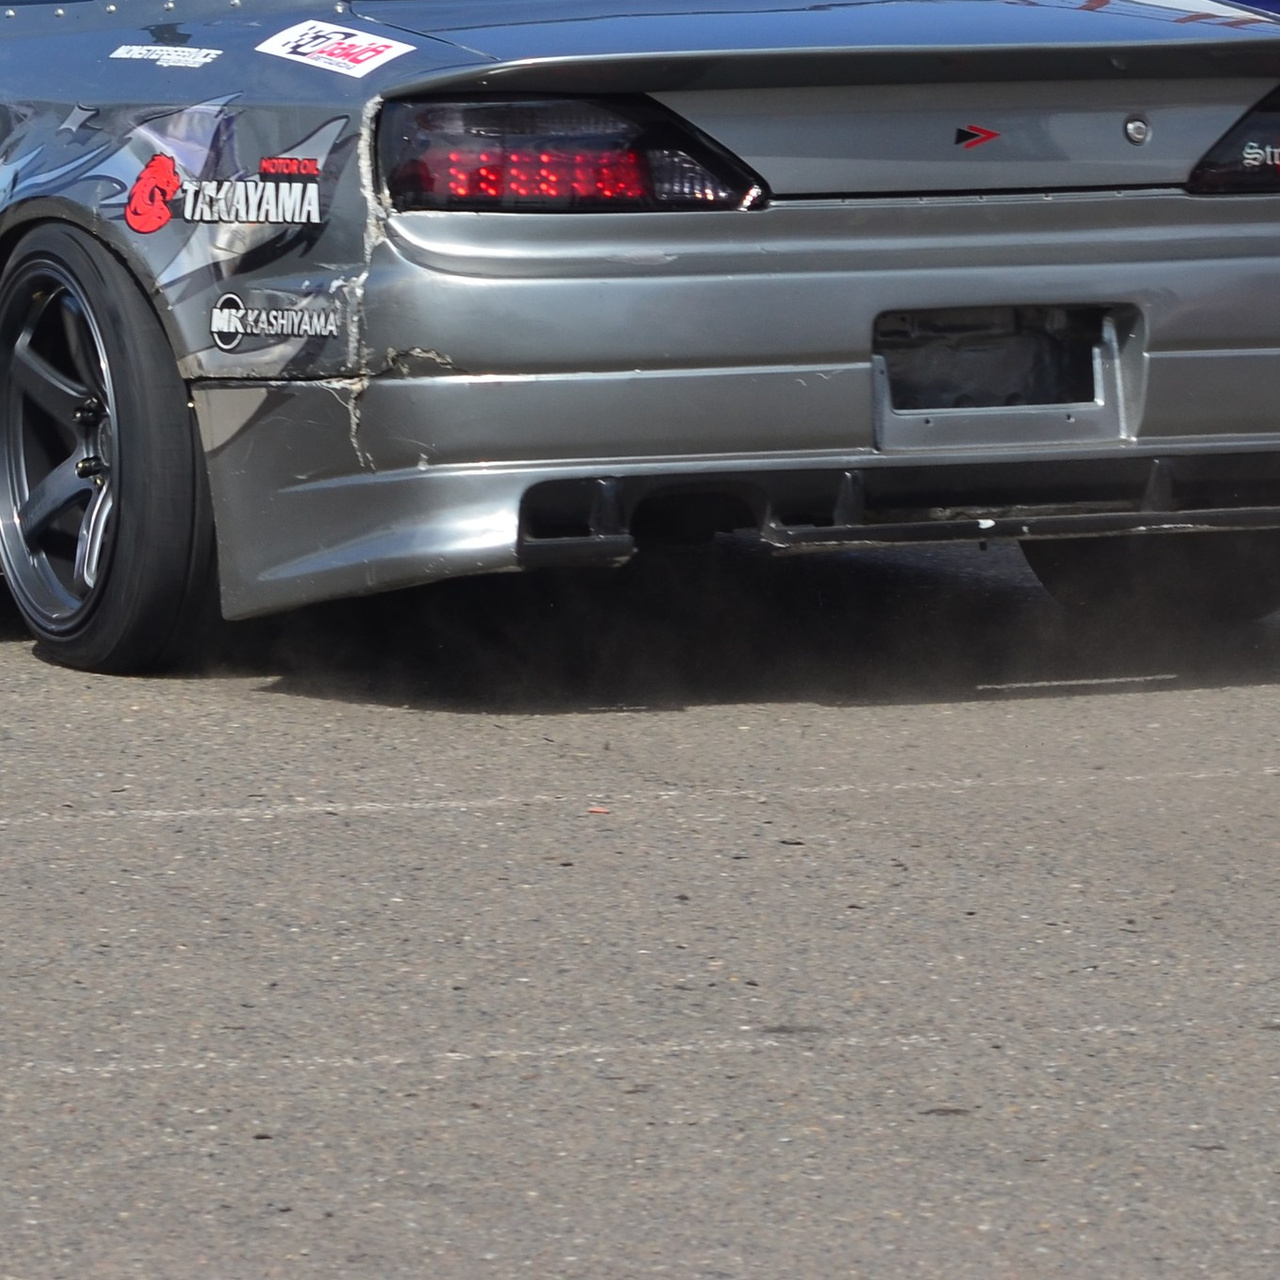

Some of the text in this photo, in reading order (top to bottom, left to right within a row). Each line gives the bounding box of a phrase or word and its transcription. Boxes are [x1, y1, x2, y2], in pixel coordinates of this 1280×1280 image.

[260, 157, 320, 175] MOTOR OIL
[182, 180, 321, 223] TAKAYAMA
[211, 308, 338, 337] MK KASHIYAMA
